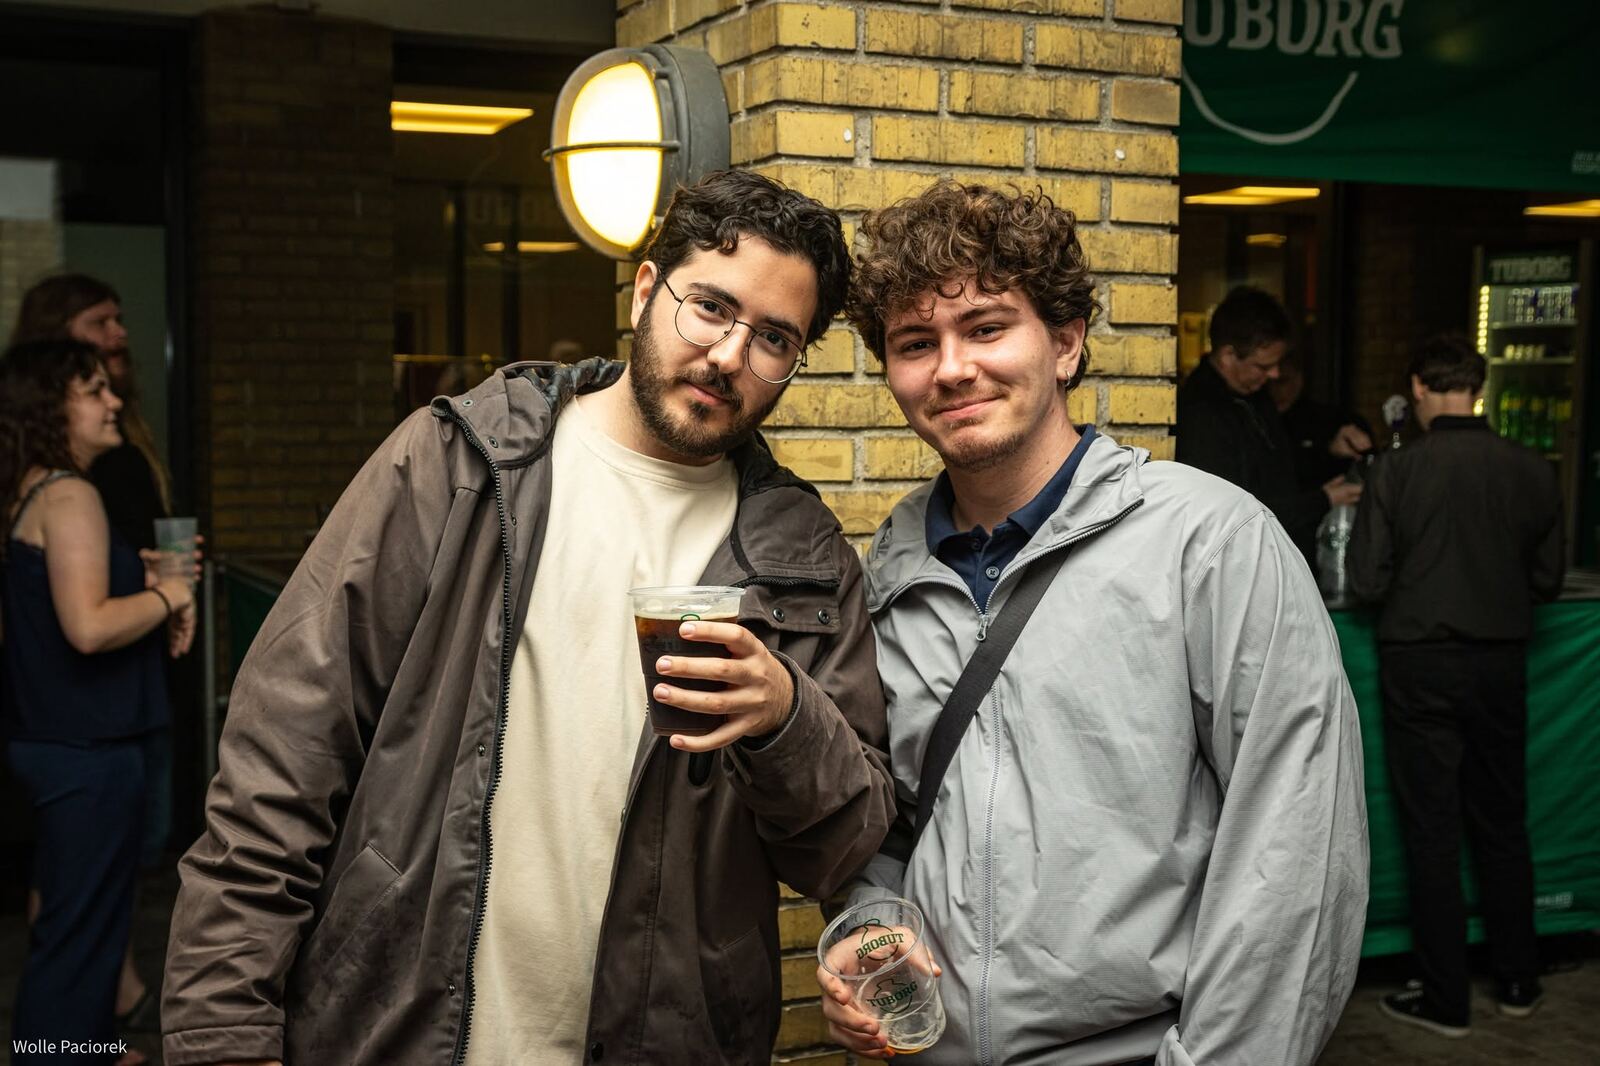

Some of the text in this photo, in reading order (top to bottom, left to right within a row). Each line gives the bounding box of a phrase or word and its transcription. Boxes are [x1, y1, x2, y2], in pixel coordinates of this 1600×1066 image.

[1183, 0, 1403, 59] UBORG
[1489, 256, 1571, 283] TUBORG
[867, 981, 918, 1007] TUBORG
